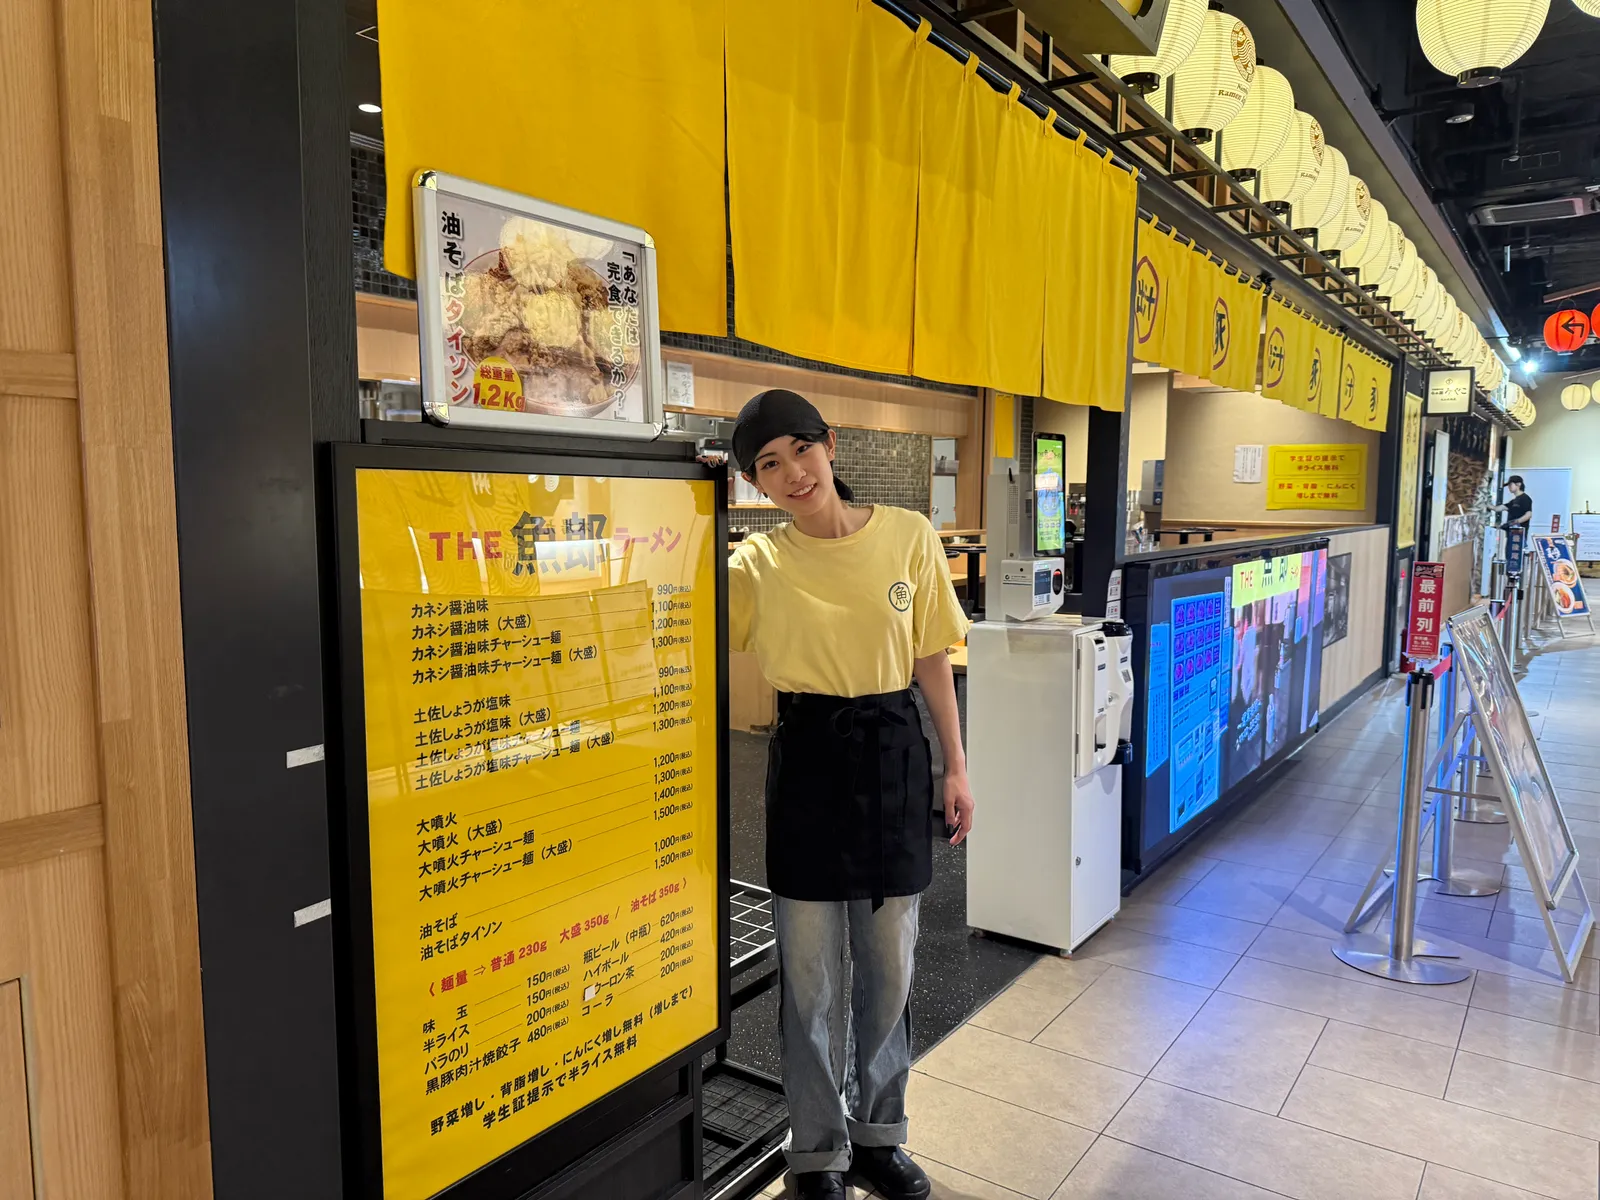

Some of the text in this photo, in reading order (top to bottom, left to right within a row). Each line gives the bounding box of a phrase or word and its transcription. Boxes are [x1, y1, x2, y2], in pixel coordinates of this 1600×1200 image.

[442, 210, 468, 402] 油そばタイソン
[473, 383, 525, 412] 1.2Kg
[429, 511, 681, 577] THE 魚郎 ラーメン
[411, 598, 488, 618] カネシ醤油味
[894, 586, 908, 605] 魚
[1417, 579, 1436, 633] 最前列
[412, 630, 561, 662] カネシ醤油味チャーシュー麺
[414, 695, 511, 724] 土佐しょうが塩味
[415, 719, 581, 768] 土佐しょうが塩味チャーシュー麺
[416, 812, 457, 835] 大噴火
[418, 830, 534, 878] 大噴火チャーシュー麺
[420, 912, 458, 940] 油そば
[420, 921, 503, 961] 油そばタイソン
[490, 950, 516, 973] 普通
[518, 939, 548, 960] 230g
[559, 920, 582, 943] 大盛
[584, 913, 610, 931] 350g
[631, 891, 657, 913] 油そば
[659, 881, 681, 900] 350g
[584, 952, 629, 981] ハイボール
[582, 966, 634, 1001] ウーロン茶
[582, 994, 613, 1016] コーラ
[422, 1023, 470, 1054] 半ライス
[424, 1042, 470, 1075] バラのり
[425, 1037, 521, 1096] 黒豚肉汁焼餃子
[483, 1034, 638, 1130] 学生証提示で半ライス無料
